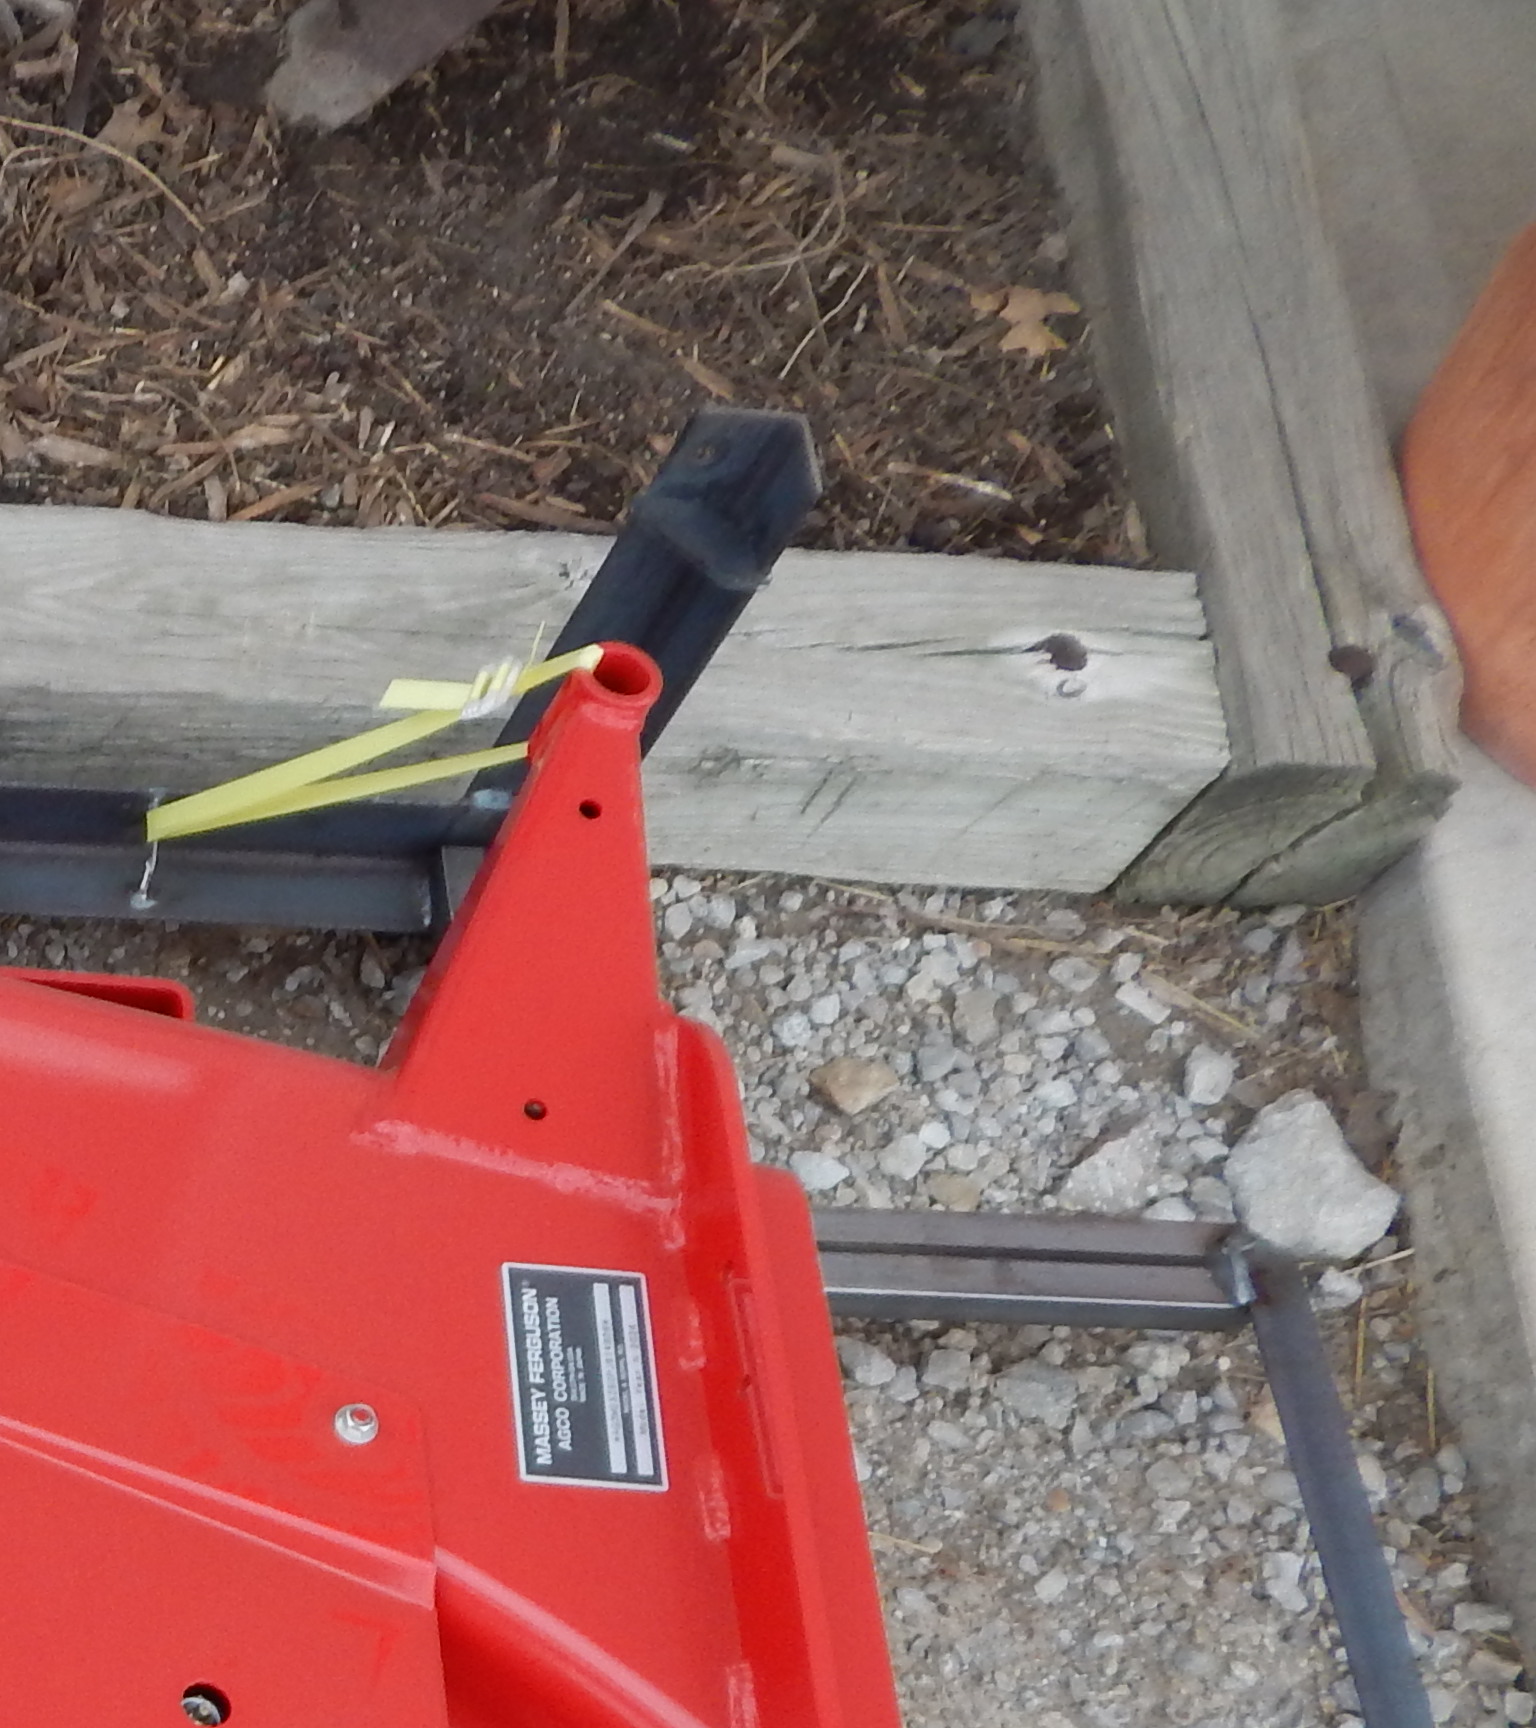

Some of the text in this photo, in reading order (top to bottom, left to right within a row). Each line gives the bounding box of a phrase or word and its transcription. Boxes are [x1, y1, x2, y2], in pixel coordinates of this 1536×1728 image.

[521, 1287, 553, 1464] MASSEY FERGUSON
[546, 1297, 568, 1402] CORPORATION
[556, 1407, 573, 1450] AGCO
